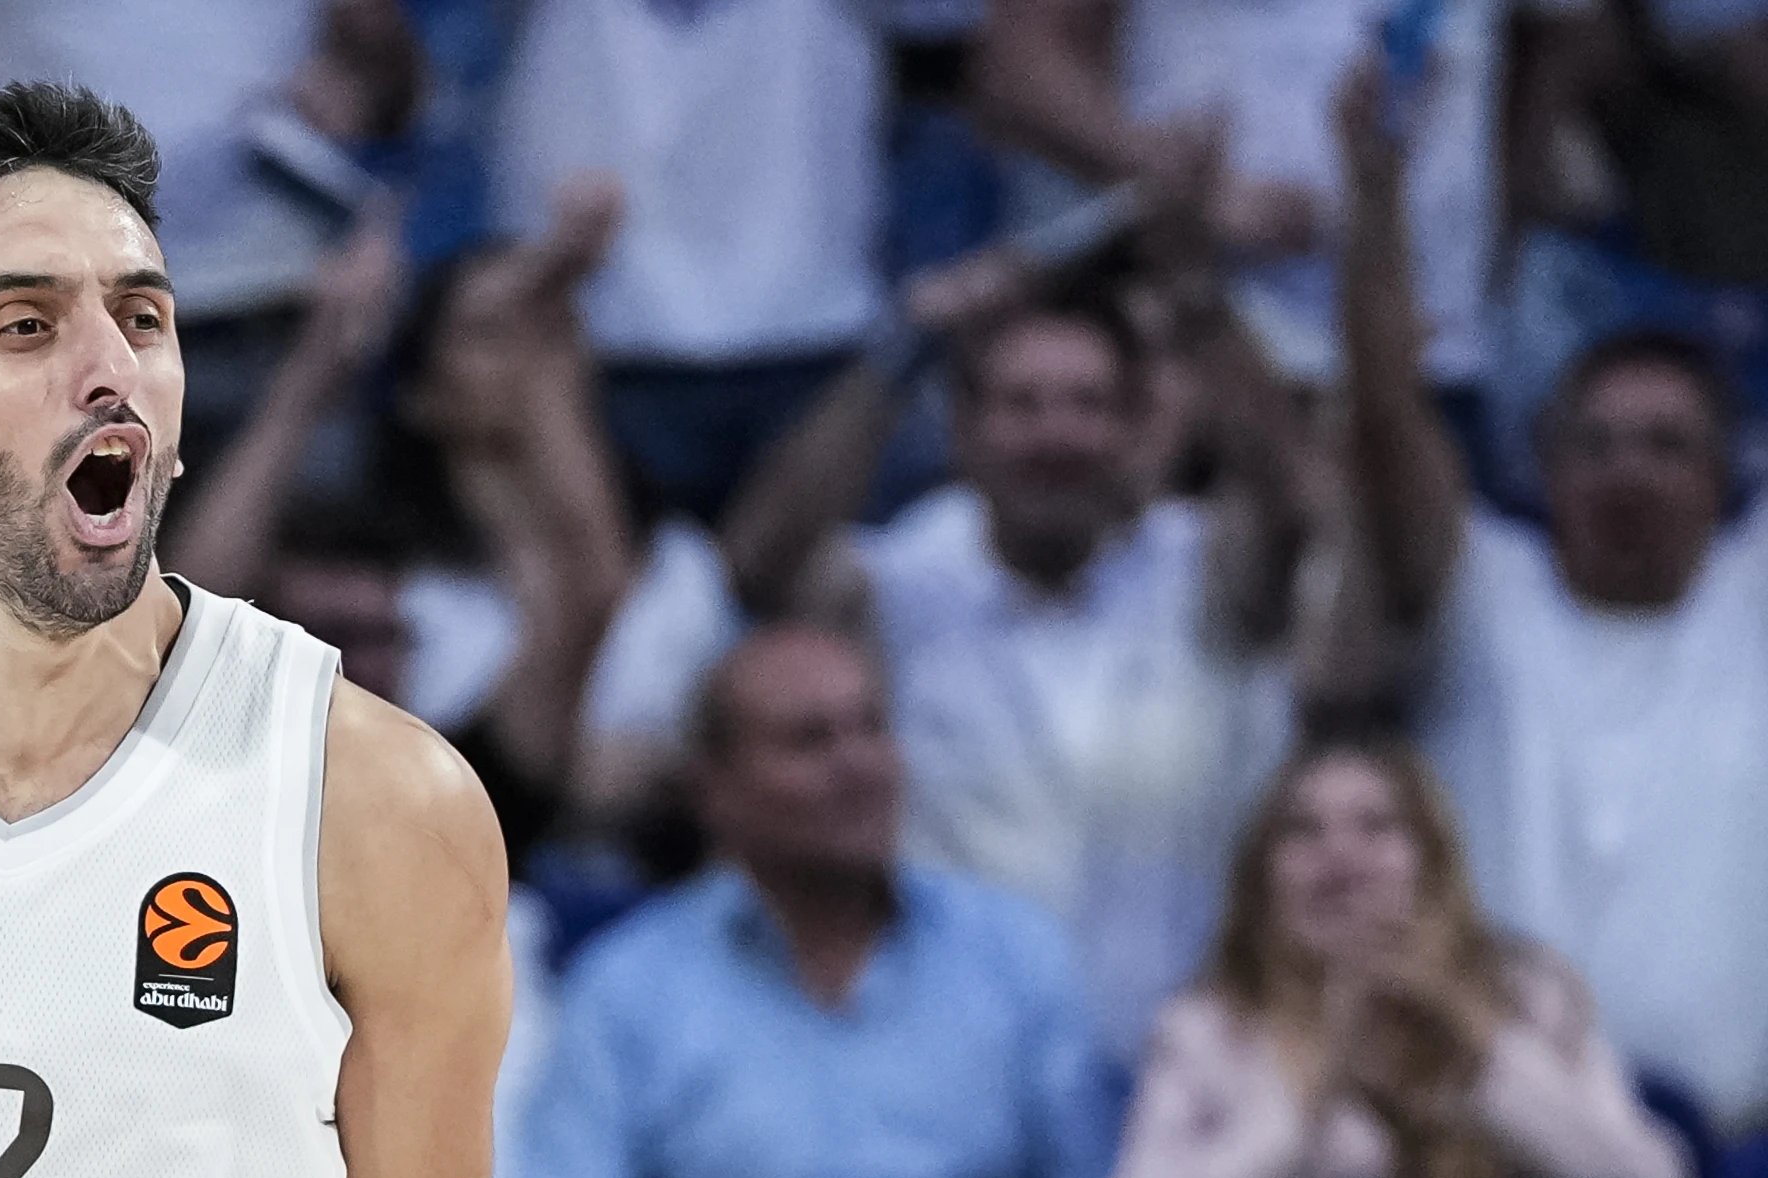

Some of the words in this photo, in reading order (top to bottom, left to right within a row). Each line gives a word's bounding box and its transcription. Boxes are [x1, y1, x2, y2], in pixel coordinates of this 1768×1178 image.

[142, 982, 191, 992] experience
[139, 990, 175, 1007] abu
[177, 993, 228, 1012] dhabi
